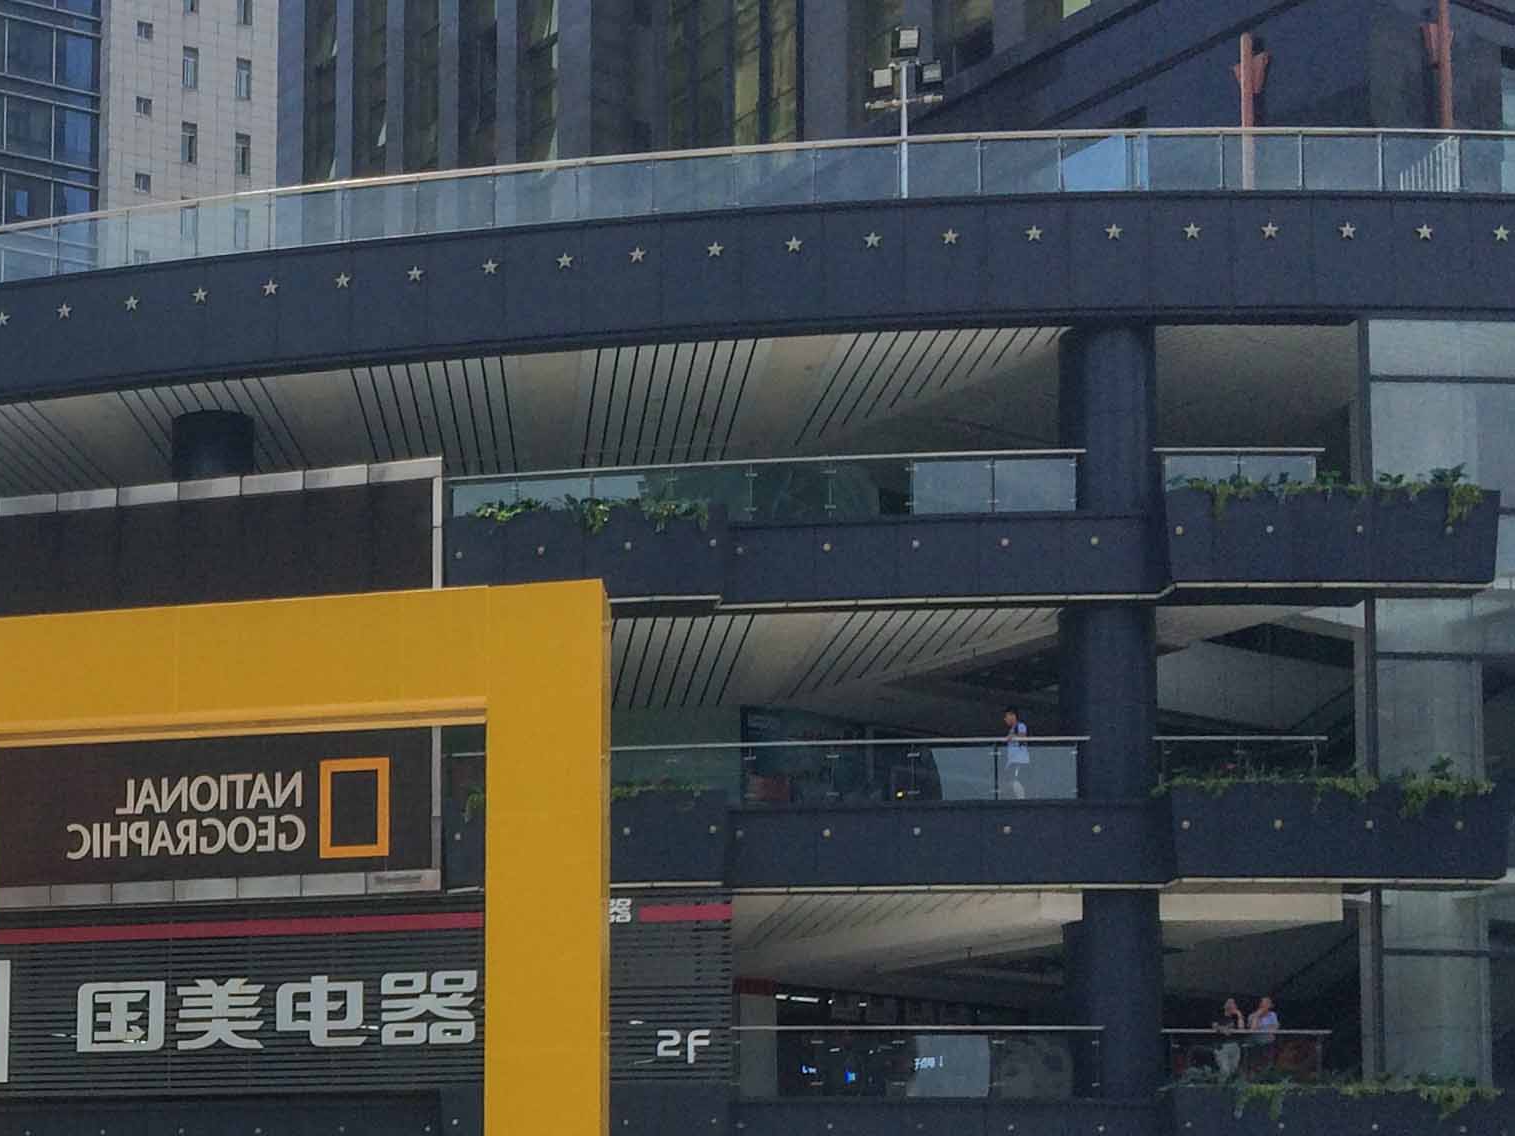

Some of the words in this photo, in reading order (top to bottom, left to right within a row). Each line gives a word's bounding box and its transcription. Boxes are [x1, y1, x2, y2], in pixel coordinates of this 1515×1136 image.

[76, 970, 478, 1053] 国美电器
[656, 1029, 711, 1064] 2F
